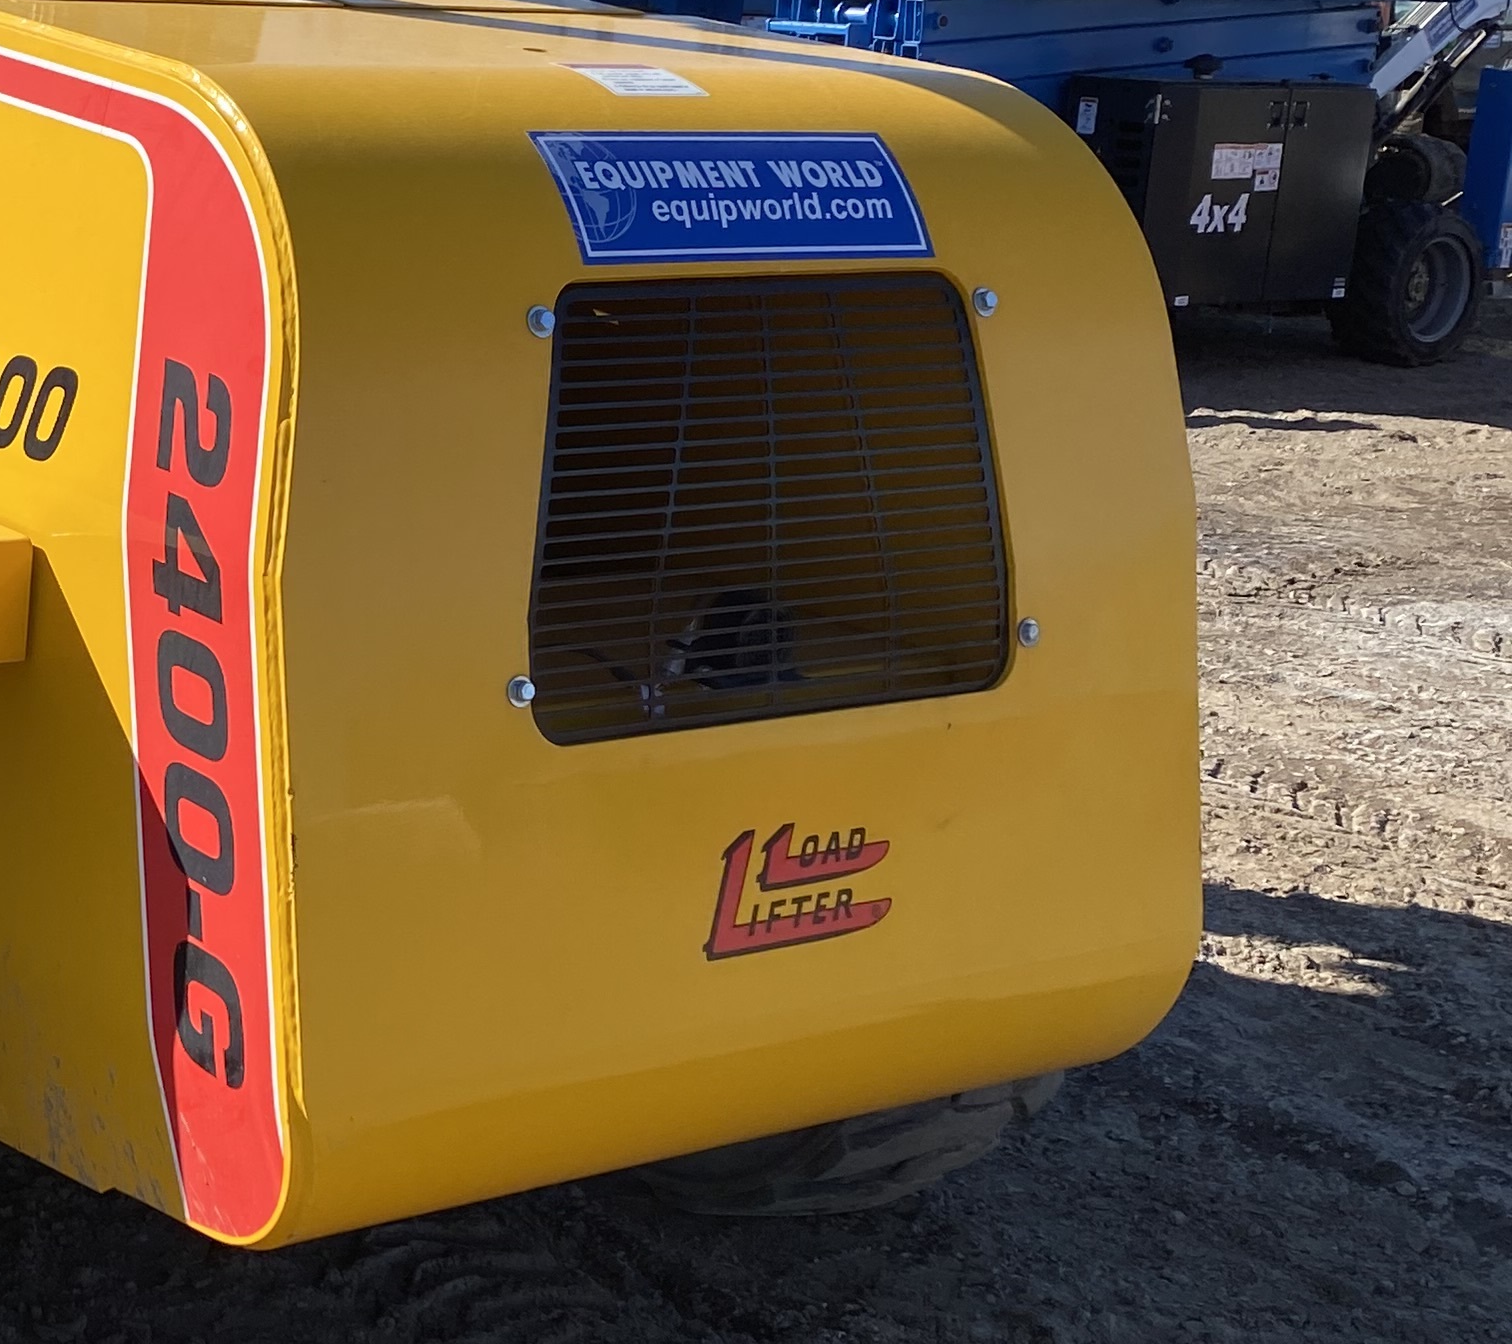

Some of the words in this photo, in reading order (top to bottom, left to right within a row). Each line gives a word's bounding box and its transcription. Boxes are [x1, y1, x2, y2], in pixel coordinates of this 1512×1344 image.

[574, 159, 757, 191] EQUIPMENT
[652, 192, 893, 228] equipworld.com
[1190, 193, 1250, 234] 4x4
[152, 358, 245, 1091] 2400-G
